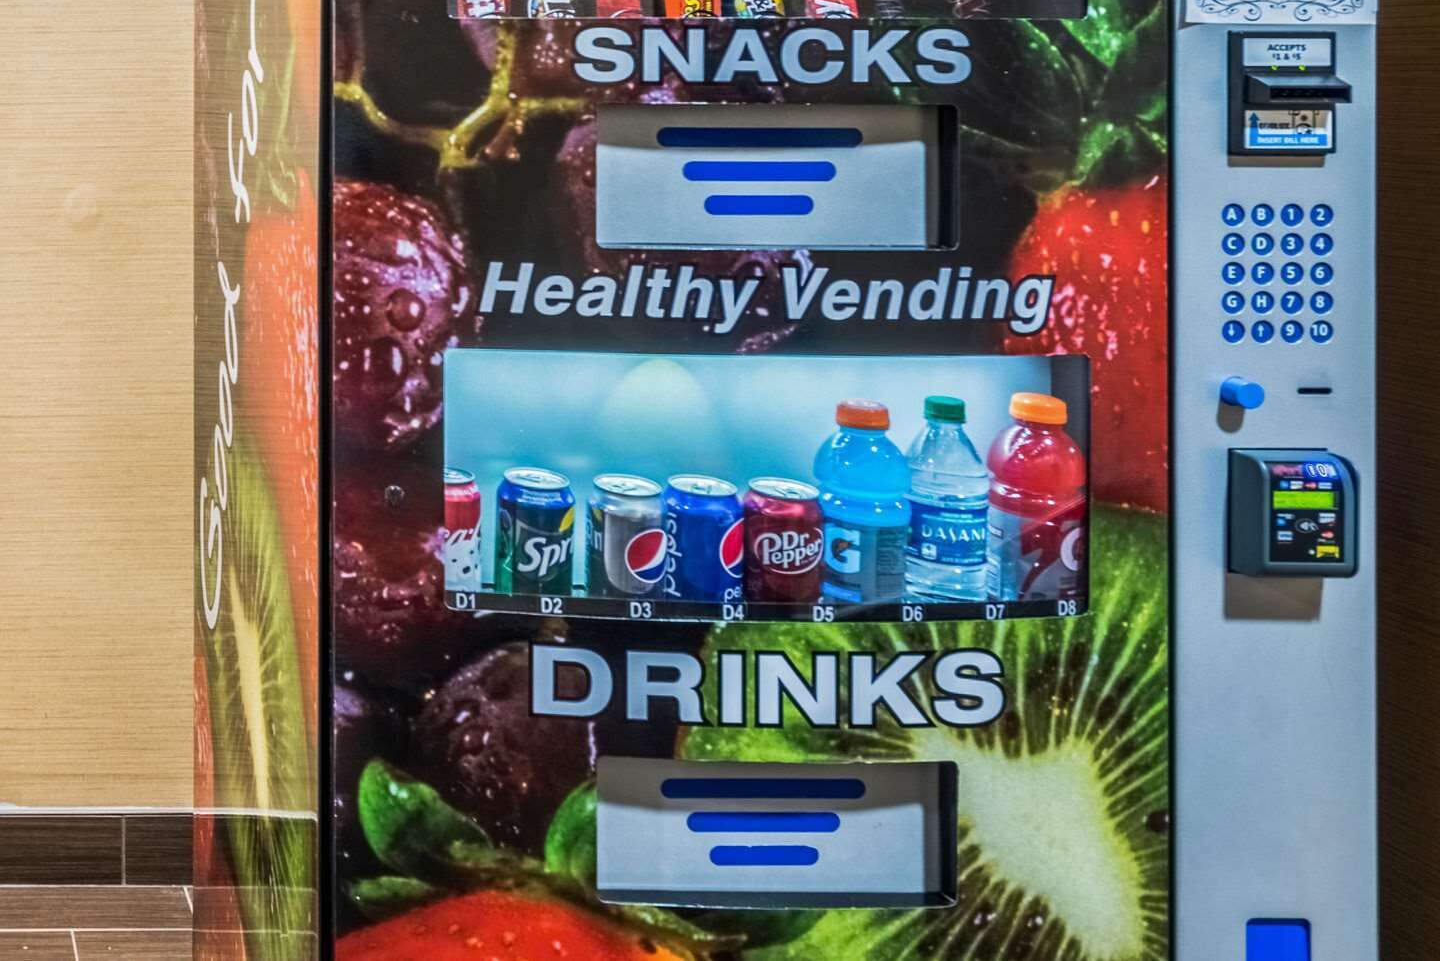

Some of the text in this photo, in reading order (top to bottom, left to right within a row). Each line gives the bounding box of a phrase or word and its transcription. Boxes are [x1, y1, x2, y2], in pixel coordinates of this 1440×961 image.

[572, 26, 973, 85] SNACKS
[1267, 44, 1307, 52] ACCEPTS
[1227, 208, 1325, 220] A B 1 2
[1227, 237, 1325, 250] C D 3 4
[1228, 266, 1325, 278] E F 5 6
[479, 261, 1055, 335] Healthy Vending
[1227, 295, 1324, 308] G H 7 8
[1286, 324, 1328, 336] 9 10
[200, 260, 241, 630] Good
[782, 530, 810, 548] Dr
[517, 536, 574, 577] Spr
[762, 534, 822, 569] Pepper
[455, 593, 476, 609] D1
[541, 597, 563, 614] D2
[630, 601, 652, 618] D3
[1058, 600, 1077, 616] D8
[722, 604, 744, 621] D4
[813, 606, 834, 622] D5
[902, 605, 923, 622] D6
[986, 604, 1006, 620] D7
[530, 645, 1006, 728] DRINKS
